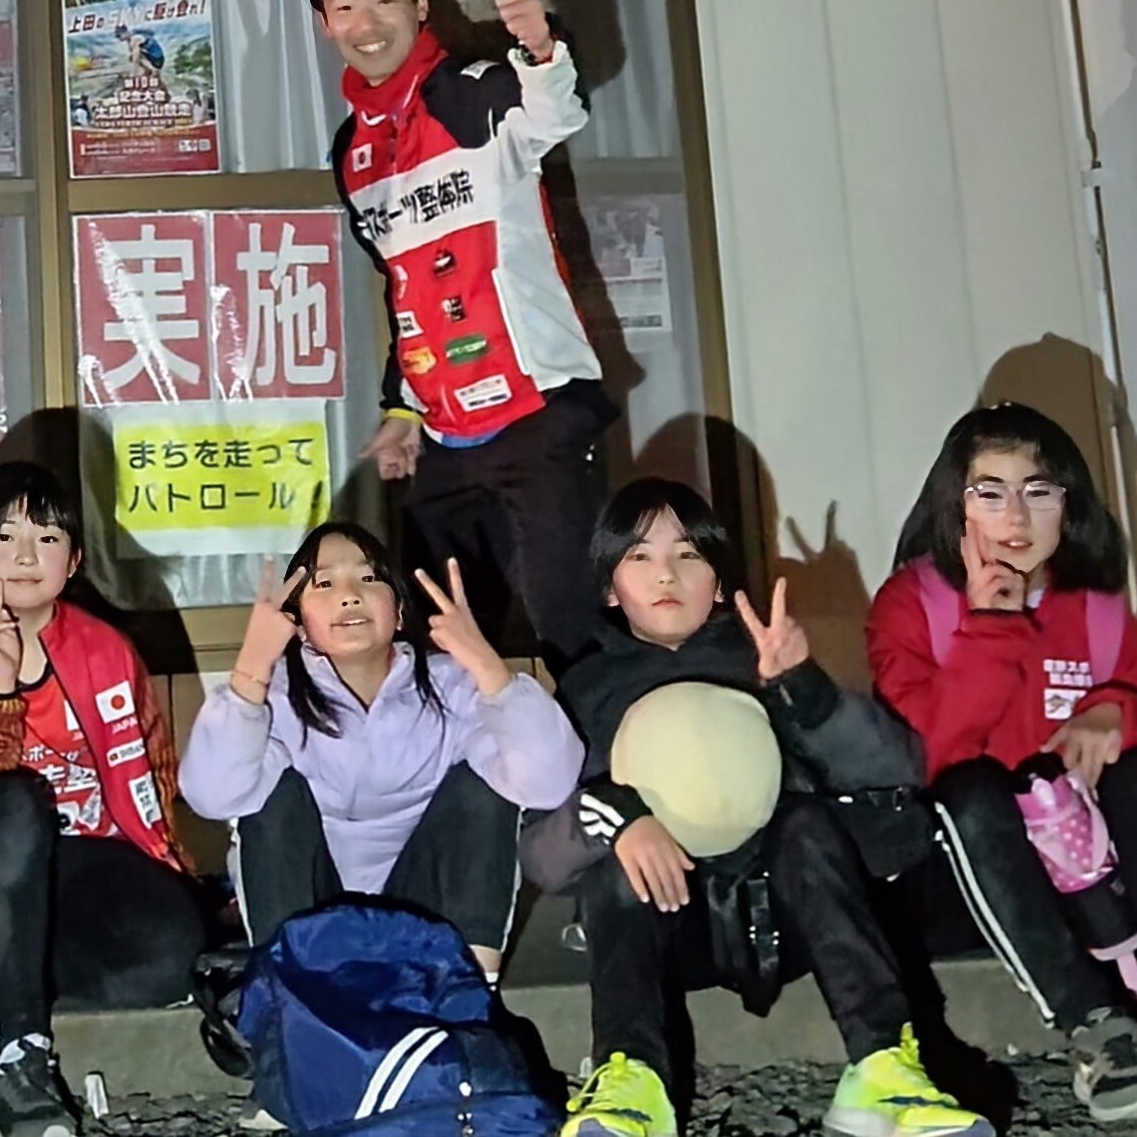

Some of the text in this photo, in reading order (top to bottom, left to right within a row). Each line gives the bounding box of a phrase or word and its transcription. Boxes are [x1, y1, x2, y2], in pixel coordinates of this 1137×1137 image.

[103, 223, 338, 387] 実施
[128, 438, 314, 469] まちを走って
[111, 716, 138, 734] JAPA
